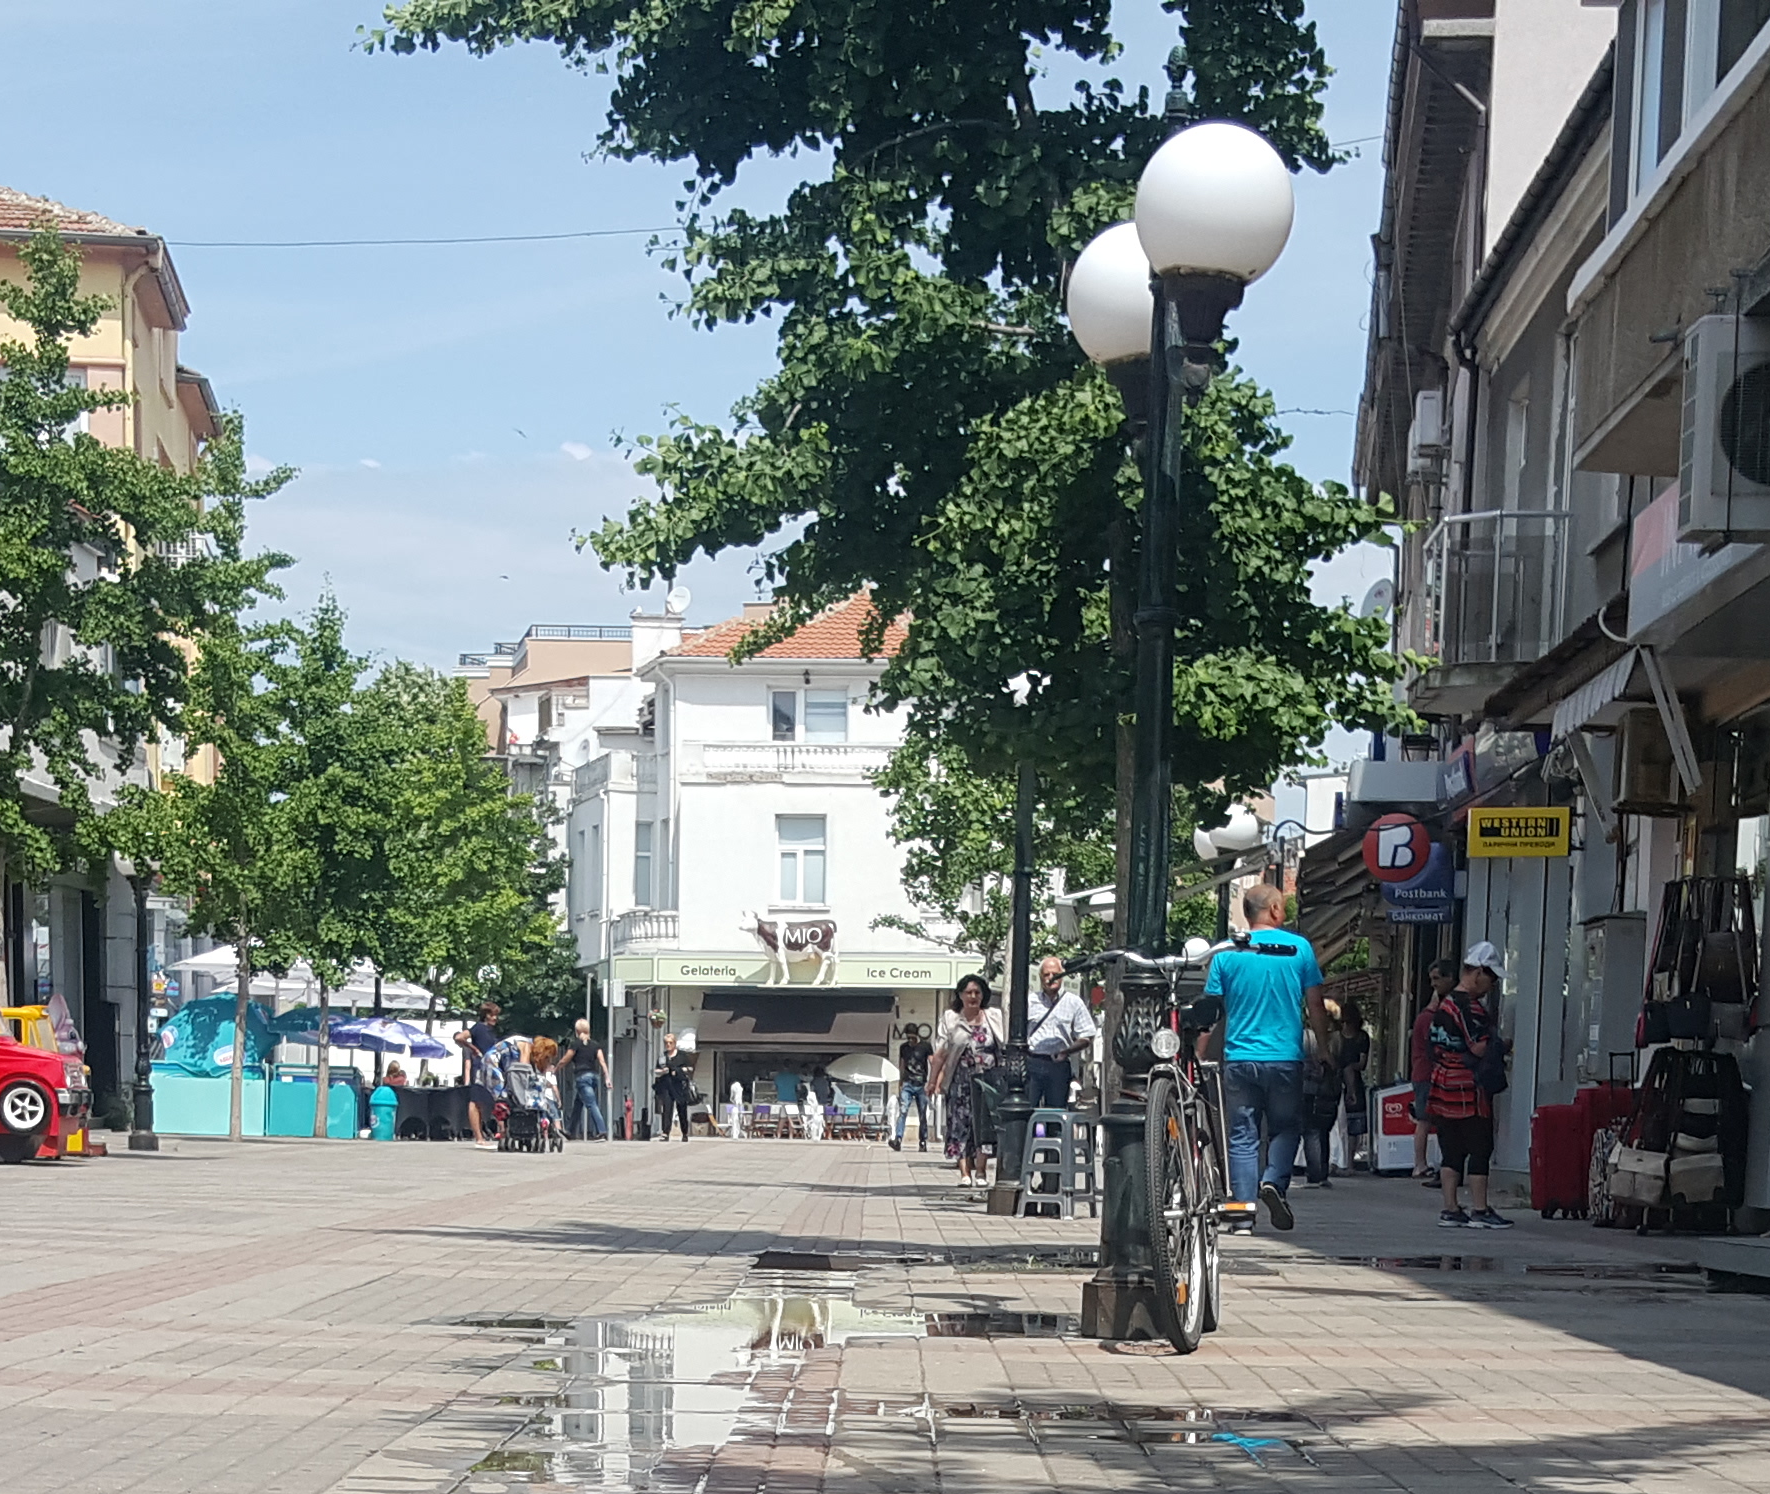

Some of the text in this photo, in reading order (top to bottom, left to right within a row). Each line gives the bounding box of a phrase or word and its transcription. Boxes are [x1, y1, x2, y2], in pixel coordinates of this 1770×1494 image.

[1480, 818, 1547, 828] WESTERN
[1500, 827, 1547, 837] UNION
[1394, 888, 1448, 899] Postbank
[785, 926, 823, 945] MIO
[680, 965, 737, 977] Gelateria
[866, 967, 932, 979] Ice Cream
[892, 1023, 933, 1041] MO
